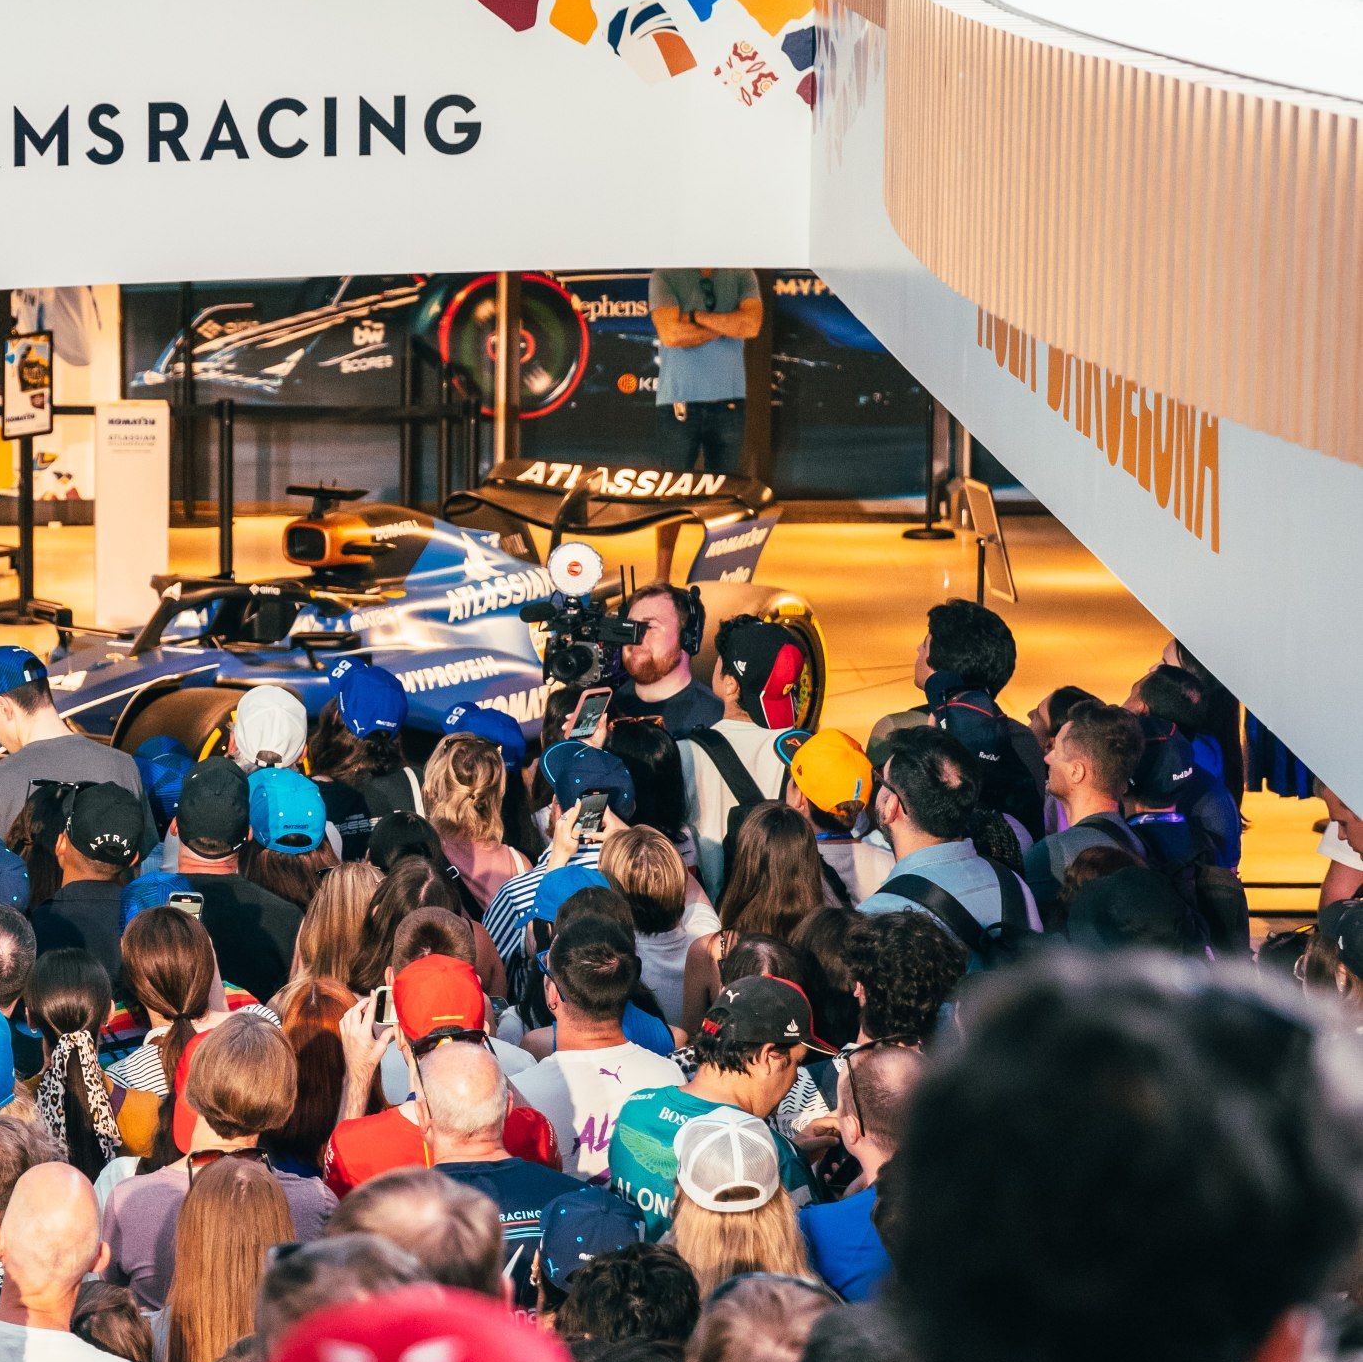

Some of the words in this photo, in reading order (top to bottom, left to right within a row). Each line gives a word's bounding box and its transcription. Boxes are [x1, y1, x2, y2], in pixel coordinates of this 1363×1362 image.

[148, 93, 483, 163] RACING
[773, 278, 831, 297] MYP
[395, 654, 502, 694] MYPROTEIN
[475, 681, 558, 724] OMAT
[571, 1112, 619, 1157] AL
[658, 1106, 688, 1126] BOS
[498, 1210, 543, 1223] RACING
[617, 1176, 674, 1218] ALON
